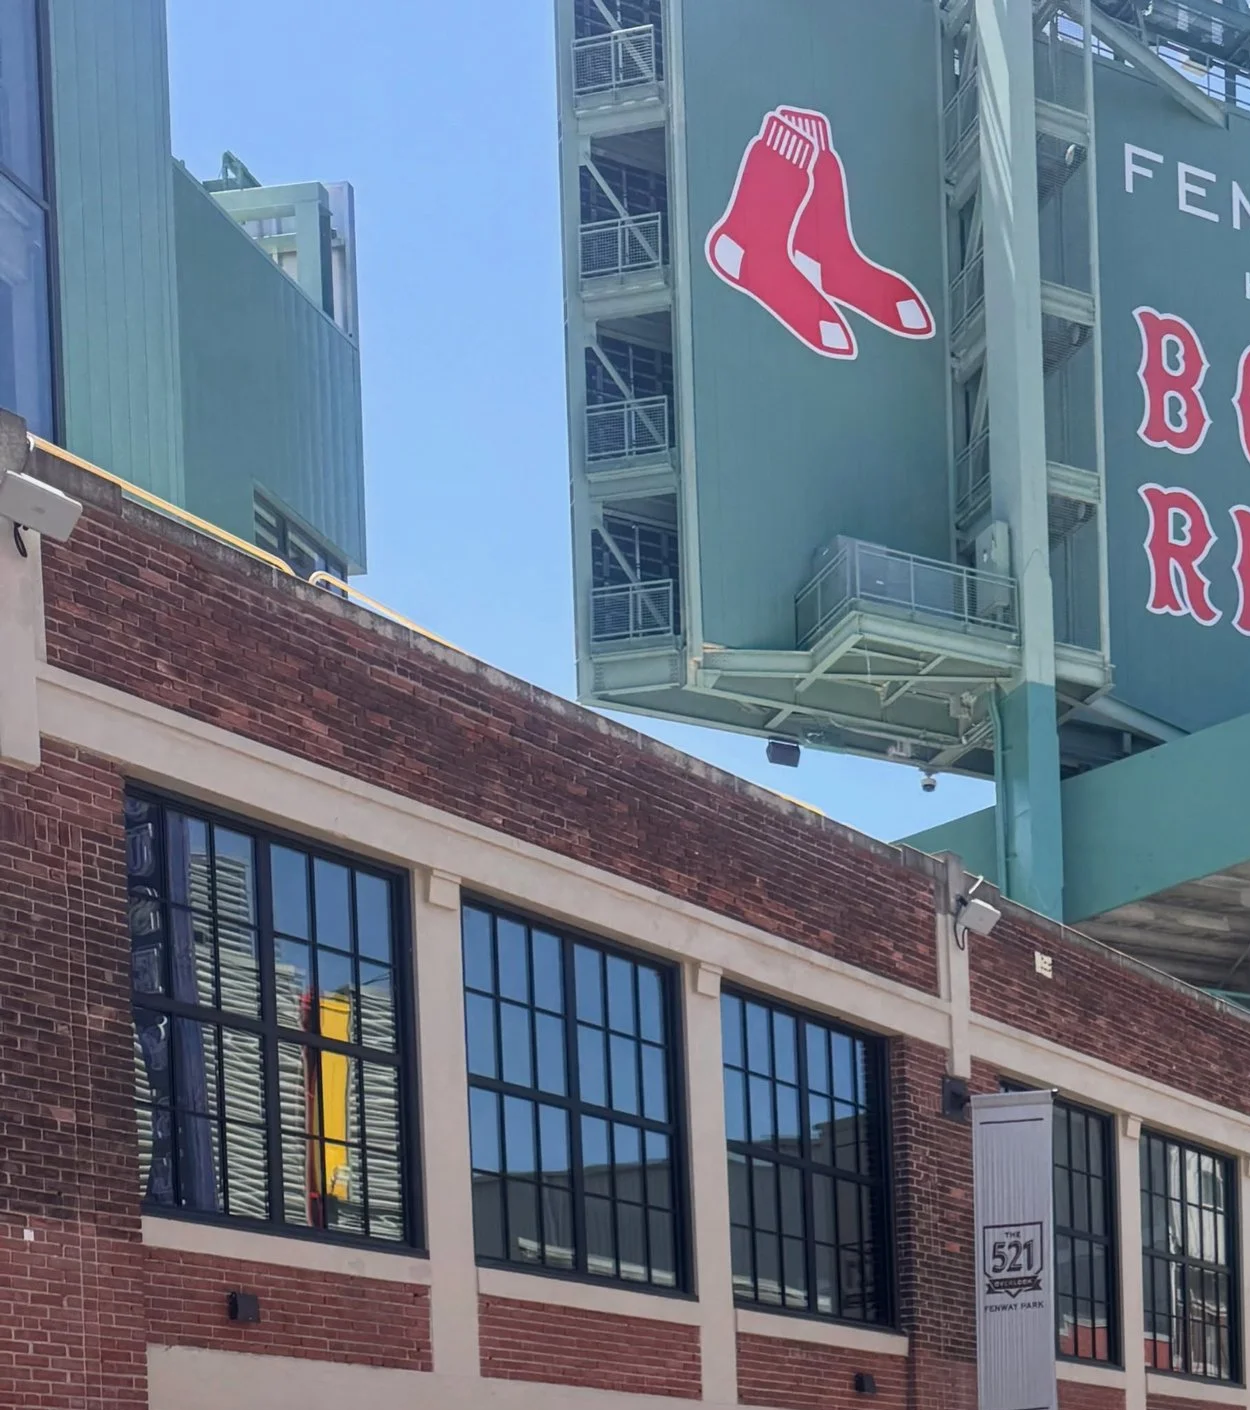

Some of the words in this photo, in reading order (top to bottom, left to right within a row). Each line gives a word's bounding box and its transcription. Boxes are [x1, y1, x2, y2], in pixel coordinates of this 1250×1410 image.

[1004, 1231, 1021, 1239] THE
[991, 1239, 1034, 1273] 521
[984, 1303, 1018, 1313] FENWAY
[1020, 1301, 1044, 1310] PARK
